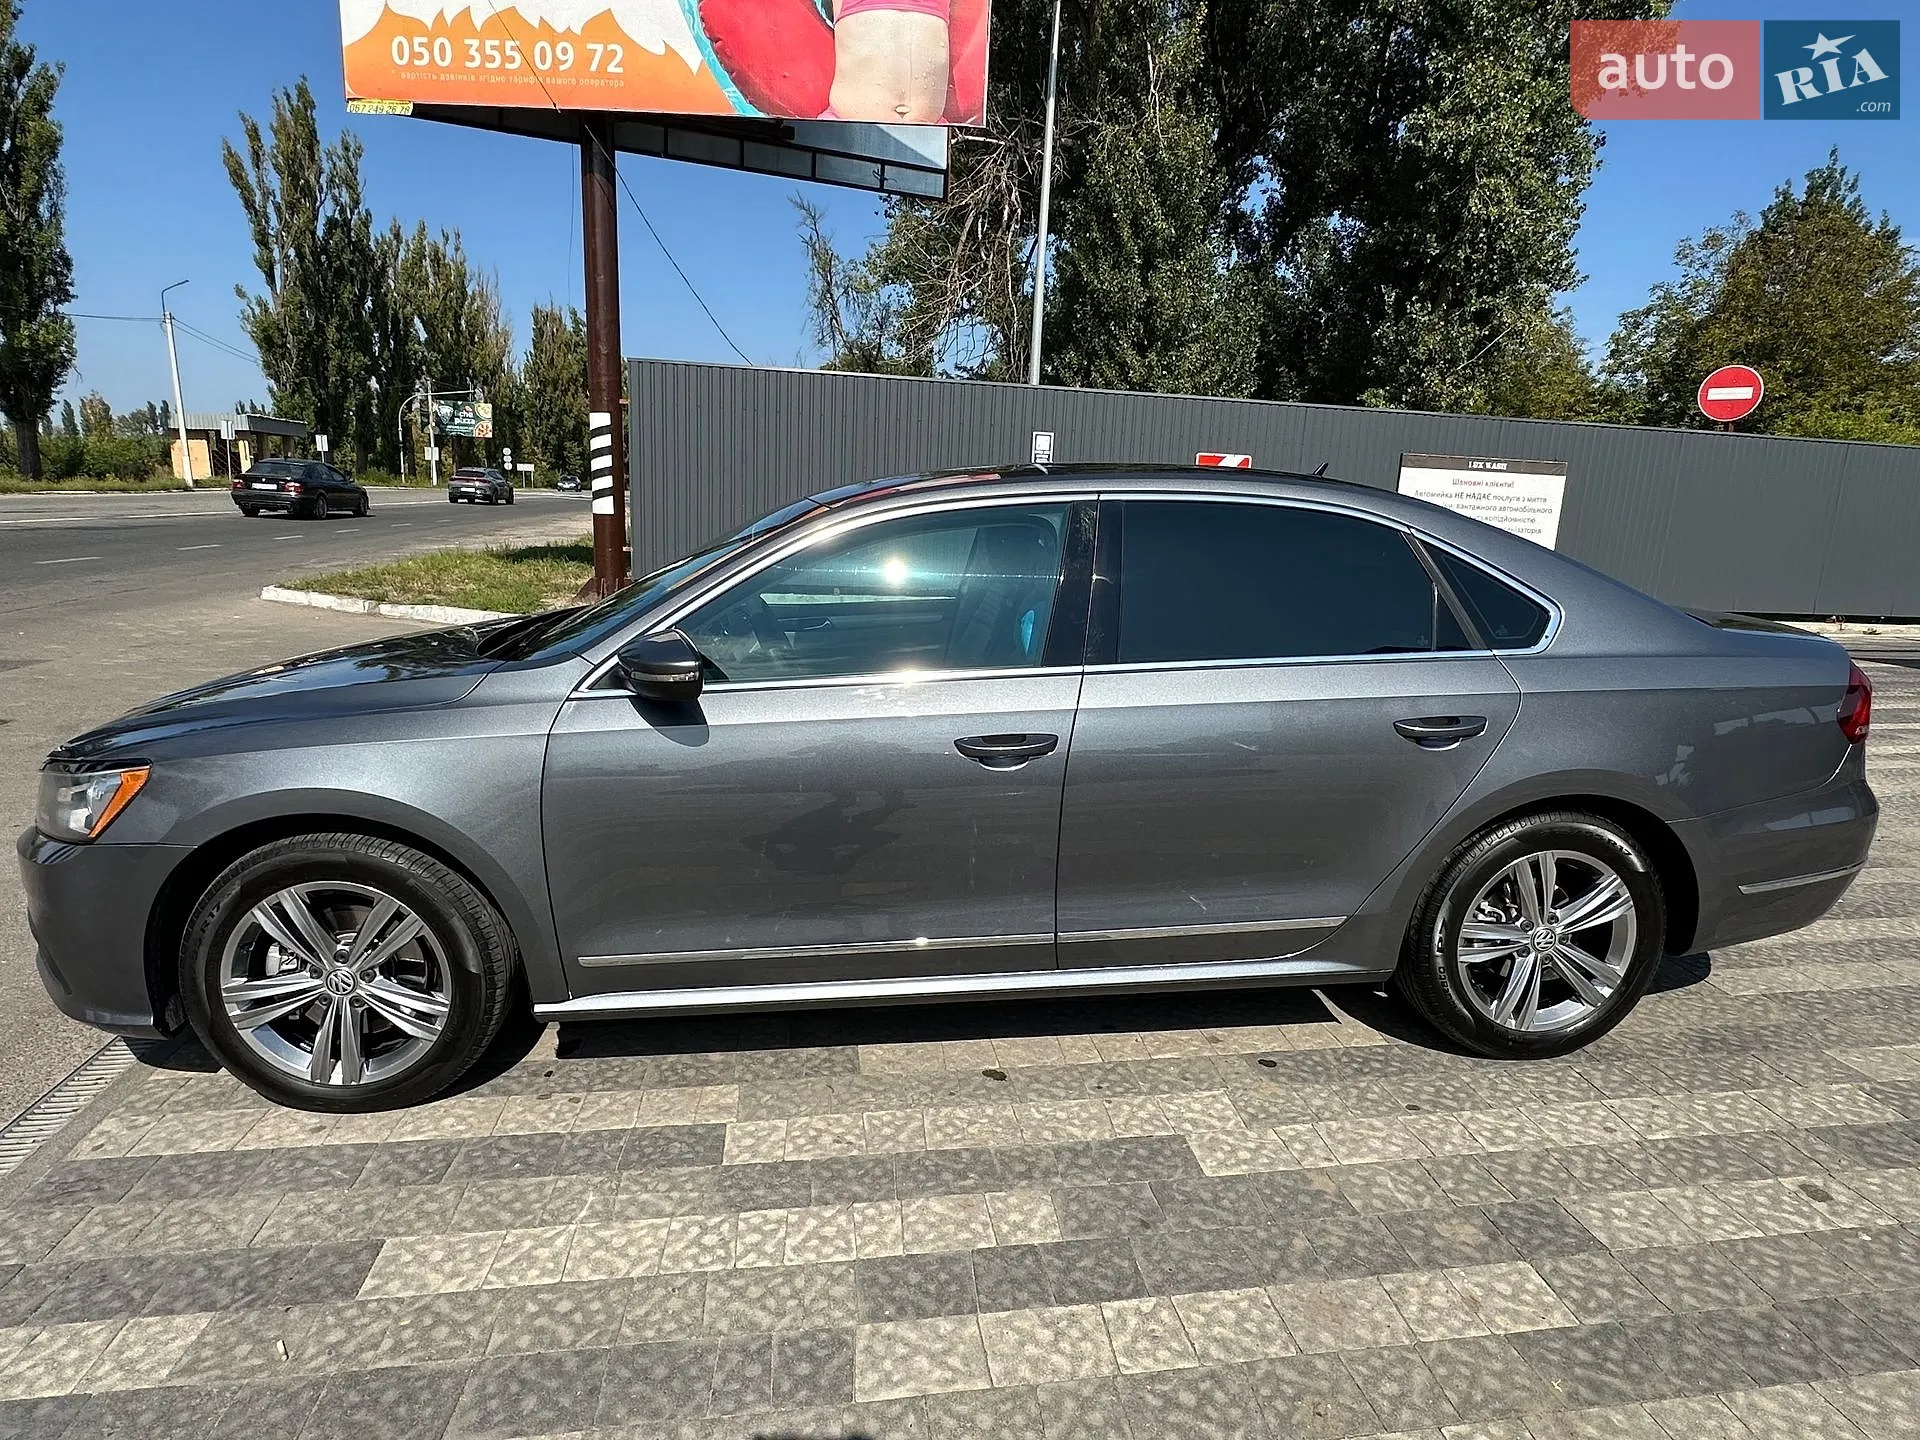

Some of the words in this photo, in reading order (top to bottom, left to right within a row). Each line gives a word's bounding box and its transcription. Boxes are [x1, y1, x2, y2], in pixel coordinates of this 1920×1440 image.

[391, 35, 453, 68] 050
[463, 38, 523, 70] 355
[533, 40, 575, 72] 09
[585, 42, 624, 73] 72
[1452, 478, 1484, 487] Шановні
[1455, 491, 1465, 499] НЕ
[1466, 492, 1492, 501] НАДАЄ
